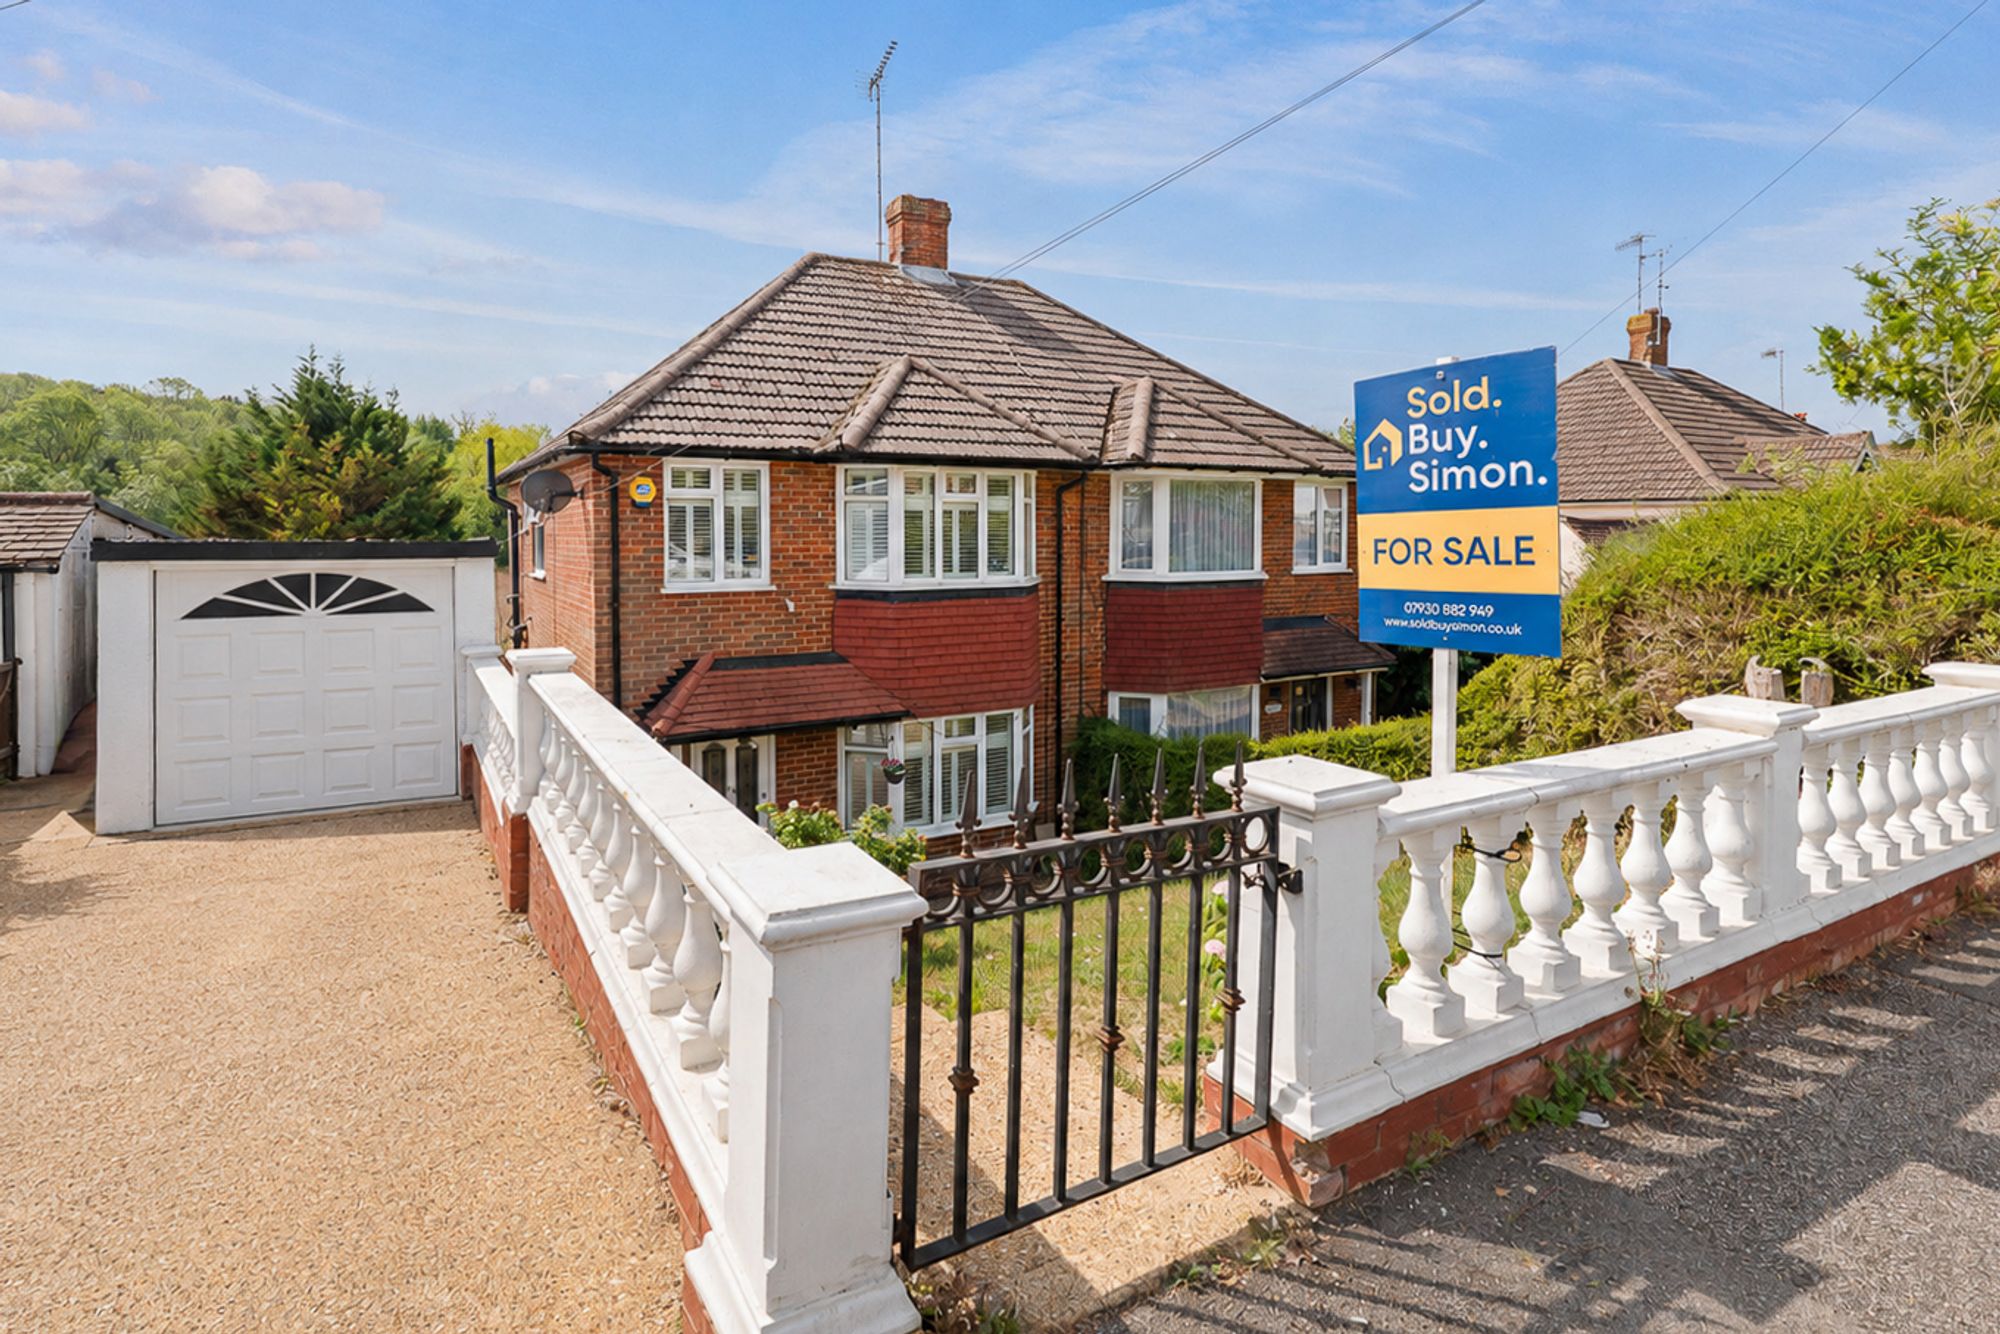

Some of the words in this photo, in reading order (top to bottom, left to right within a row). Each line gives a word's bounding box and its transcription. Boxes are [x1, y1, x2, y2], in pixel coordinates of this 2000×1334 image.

[1407, 376, 1502, 418] Sold.
[1408, 423, 1488, 459] Buy.
[1408, 458, 1548, 493] Simon.
[1373, 537, 1433, 566] FOR
[1443, 536, 1536, 566] SALE
[1403, 601, 1440, 615] 07930
[1442, 604, 1466, 617] 882
[1468, 605, 1494, 618] 949
